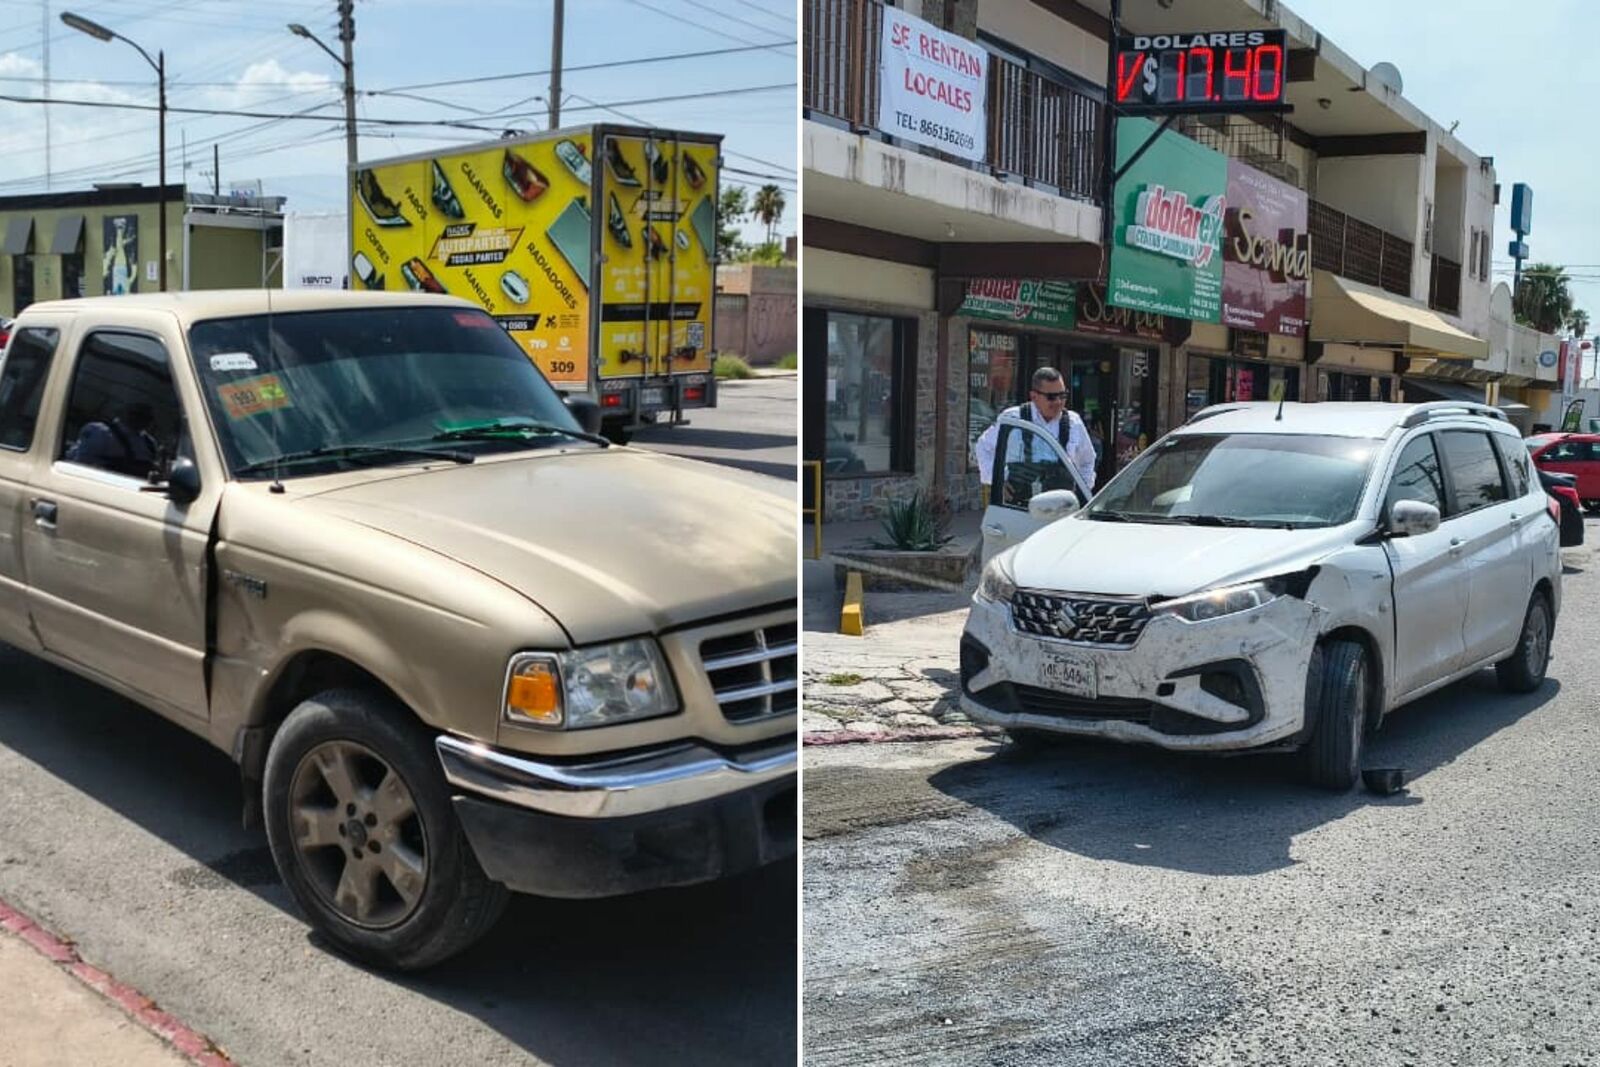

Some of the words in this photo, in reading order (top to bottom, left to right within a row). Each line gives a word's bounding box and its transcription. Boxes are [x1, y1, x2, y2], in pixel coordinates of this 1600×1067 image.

[891, 22, 911, 50] SE
[919, 33, 982, 78] RENTAN
[1134, 32, 1265, 50] DOLARES
[904, 67, 972, 113] LOCALES
[1176, 45, 1282, 101] 17.40
[895, 110, 918, 131] TEL:
[404, 186, 428, 220] FAROS
[461, 162, 503, 219] CALAVERAS
[364, 228, 390, 265] COFRES
[1234, 207, 1312, 298] Scandal
[464, 267, 496, 312] MANIJAS
[526, 242, 577, 310] RADIADORES
[550, 361, 575, 373] 309
